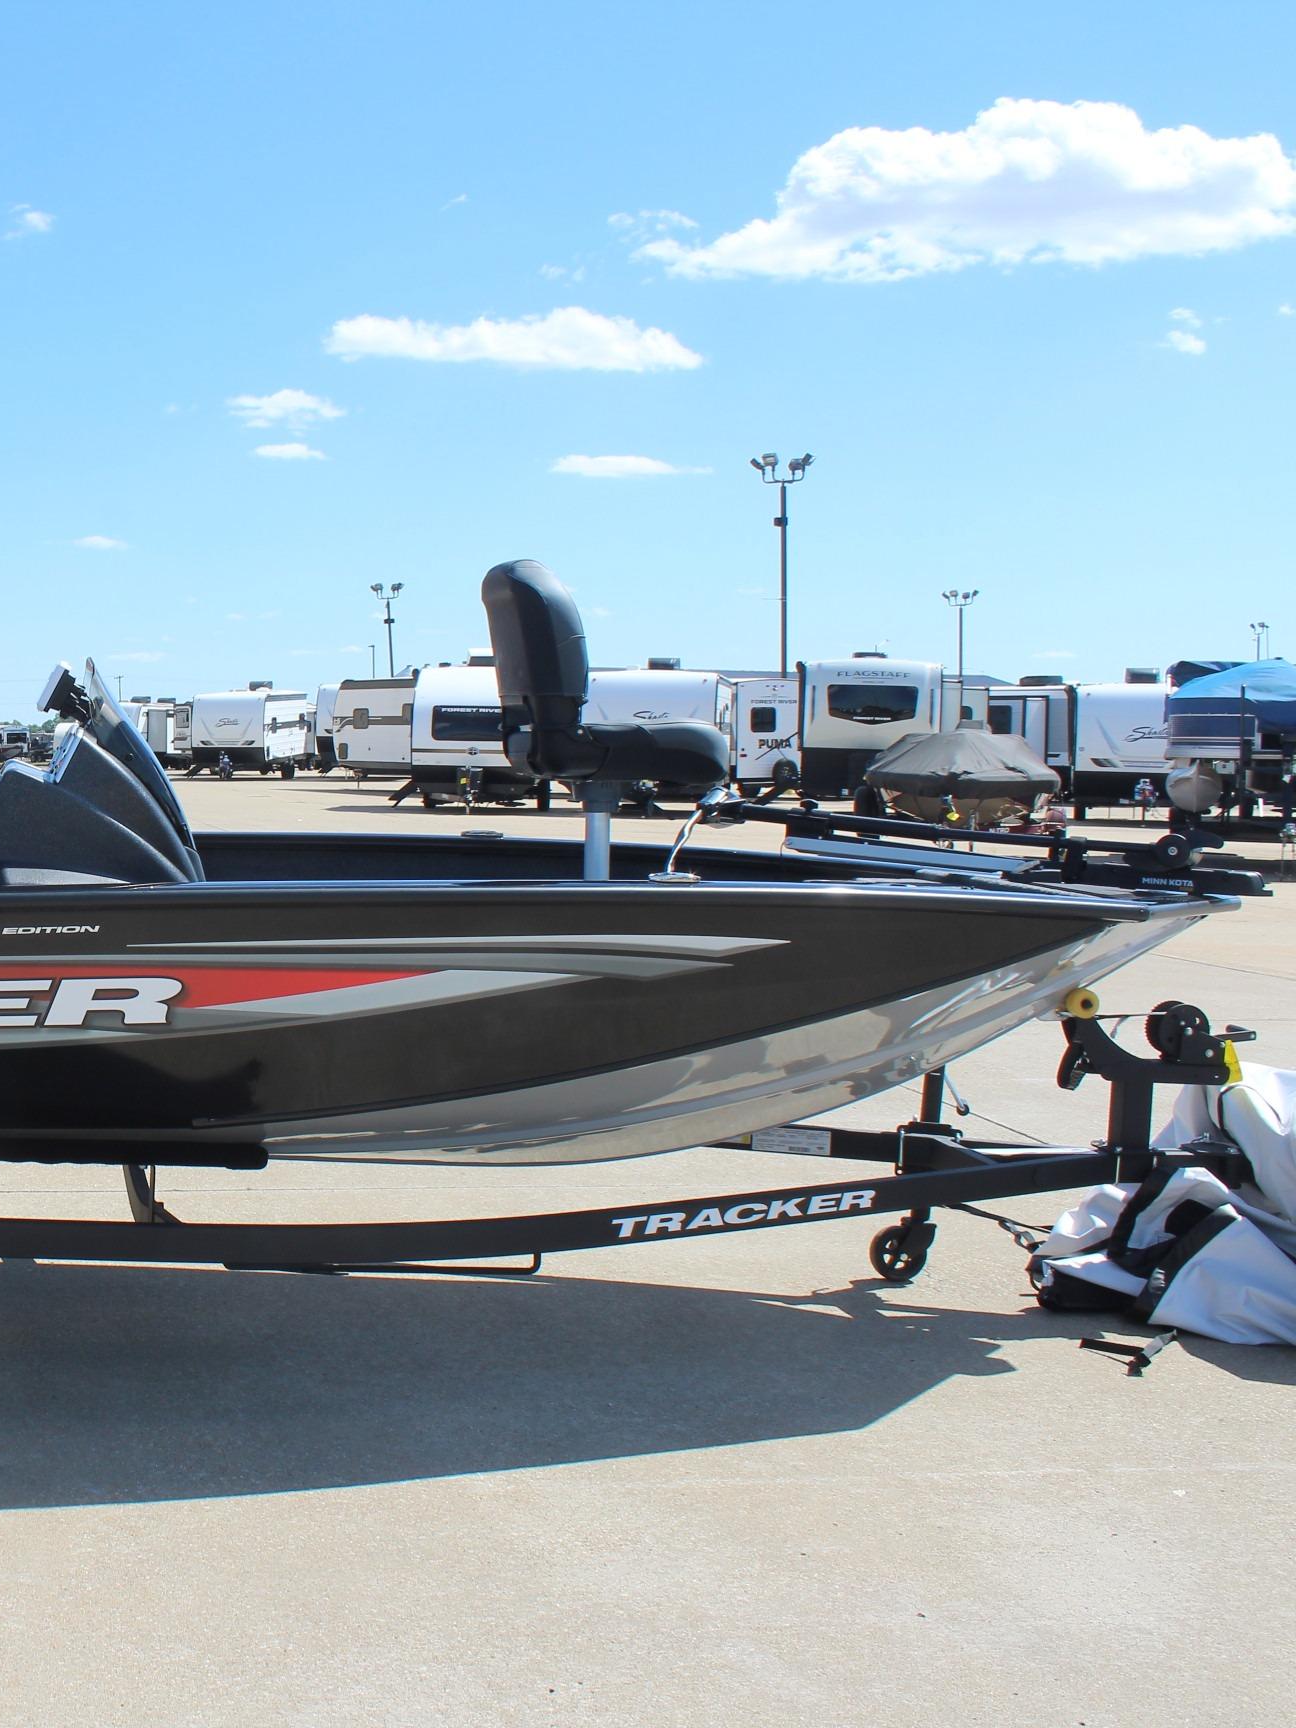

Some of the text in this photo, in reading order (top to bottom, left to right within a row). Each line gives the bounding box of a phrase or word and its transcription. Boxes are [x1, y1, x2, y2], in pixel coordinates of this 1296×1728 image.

[837, 670, 911, 679] FLAGSTAFF
[758, 738, 792, 750] PUMA
[1141, 877, 1194, 887] MINN KOTA
[2, 925, 100, 935] EDITION
[611, 1189, 876, 1238] TRACKER
